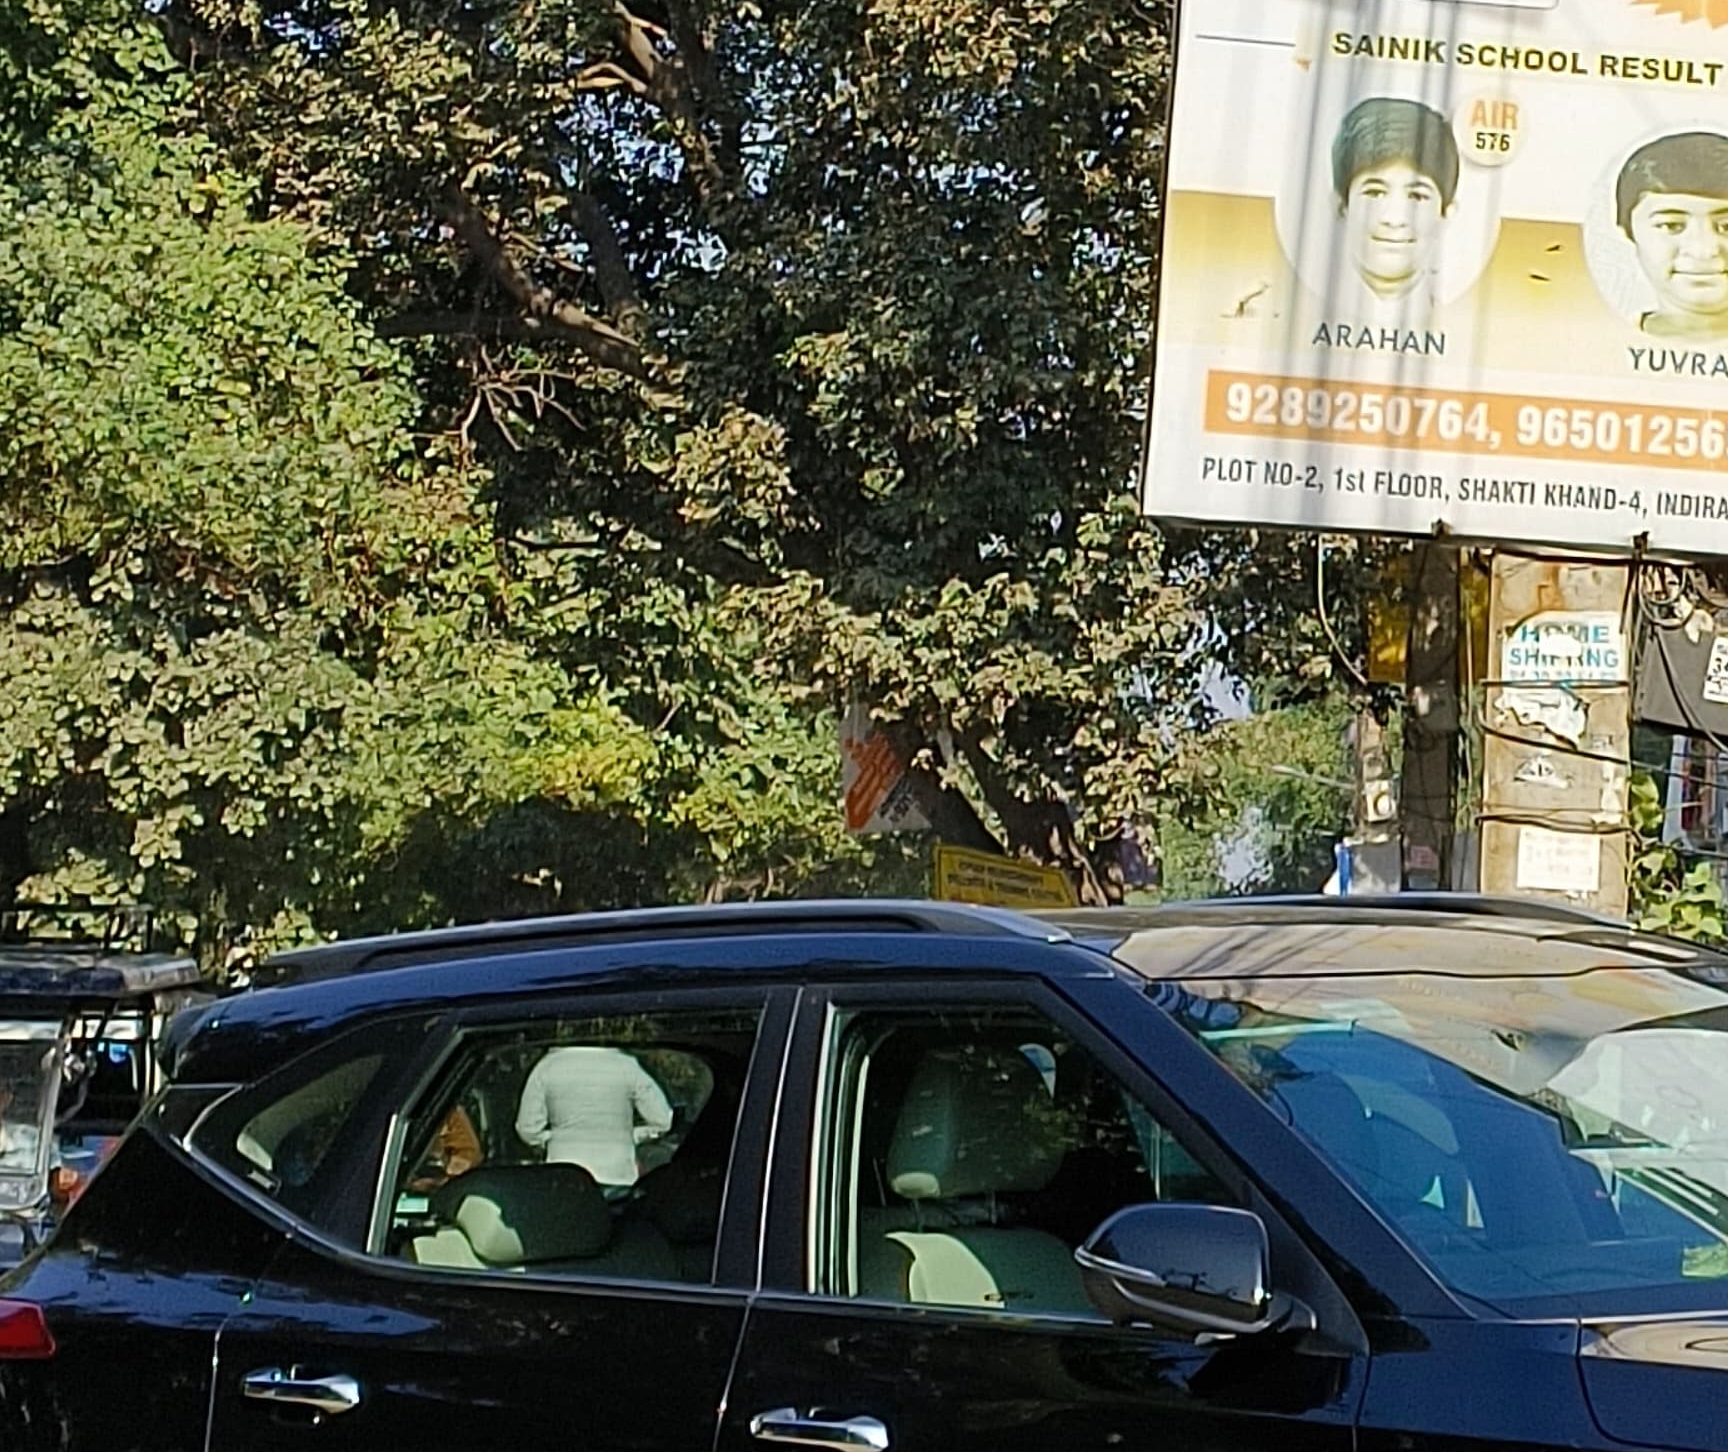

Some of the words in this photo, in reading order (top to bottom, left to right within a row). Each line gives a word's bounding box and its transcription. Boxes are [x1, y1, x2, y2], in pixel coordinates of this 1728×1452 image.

[1333, 33, 1447, 64] SAINIK
[1456, 43, 1588, 75] SCHOOL
[1599, 55, 1724, 86] RESULT
[1471, 100, 1519, 130] AIR
[1475, 132, 1511, 151] 576
[1312, 322, 1446, 356] ARAHAN
[1227, 382, 1501, 450] 9289250764,
[1202, 457, 1257, 484] PLOT
[1334, 467, 1366, 494] 1st
[1374, 470, 1451, 502] FLOOR,
[1458, 478, 1535, 505] SHAKTI
[1544, 487, 1649, 518] KHAND-4,
